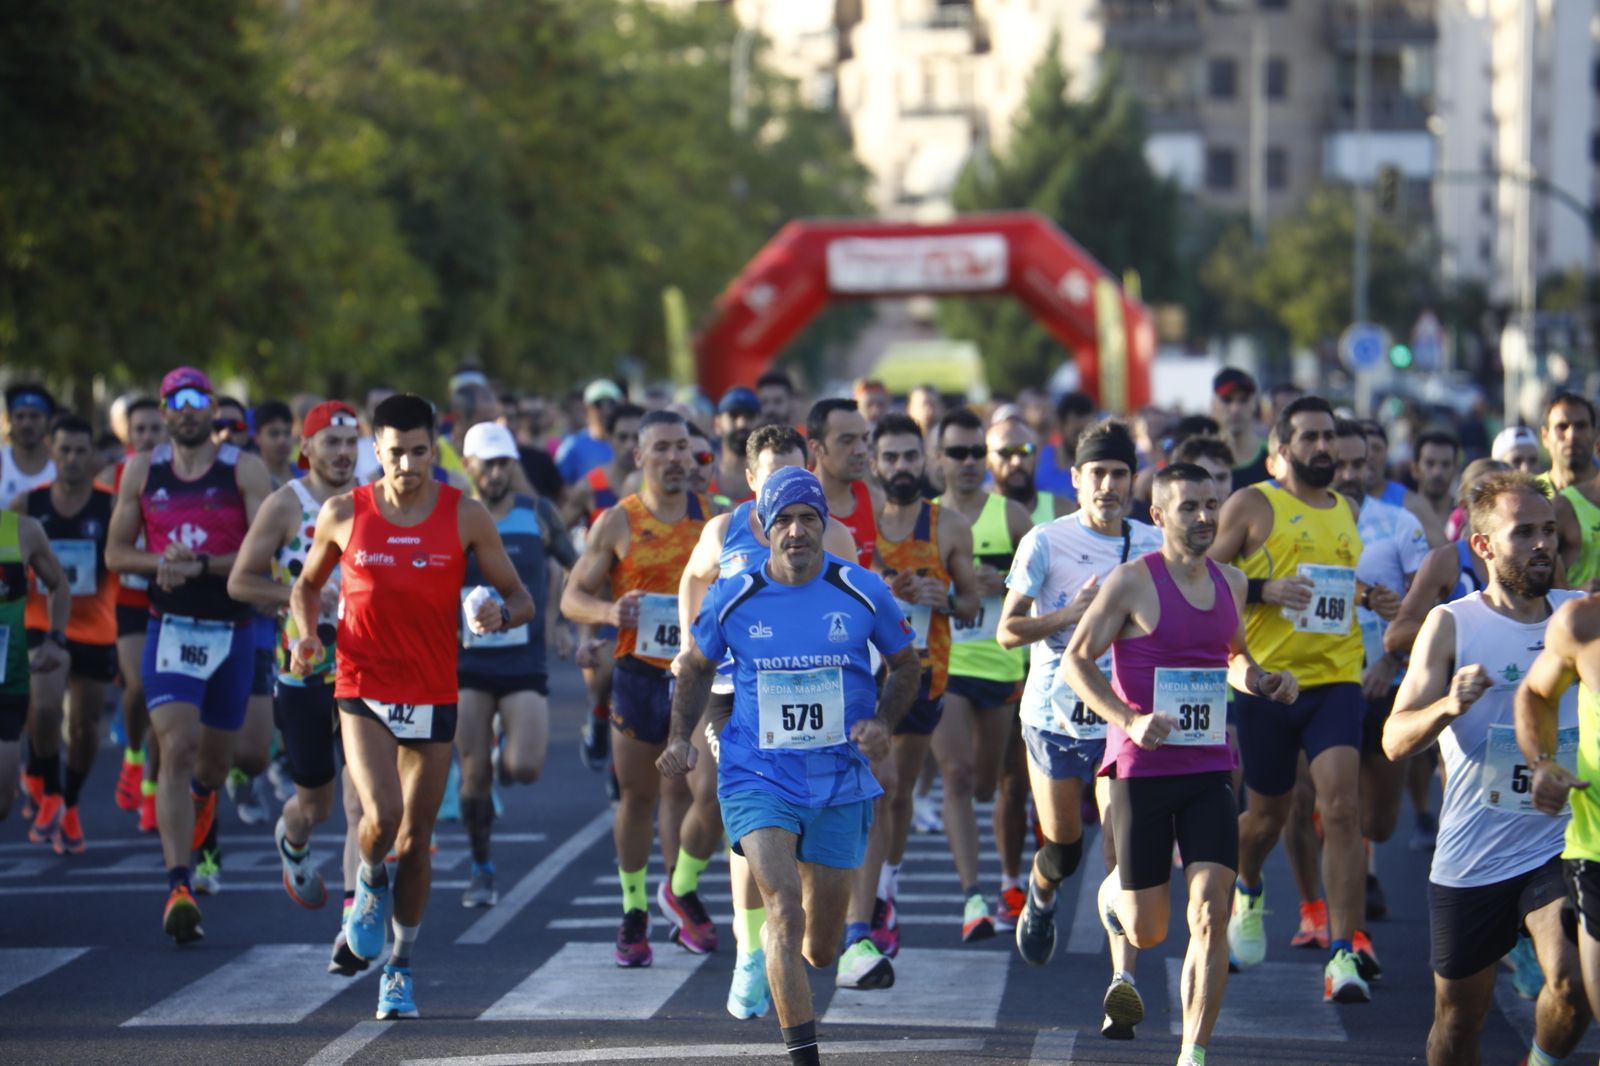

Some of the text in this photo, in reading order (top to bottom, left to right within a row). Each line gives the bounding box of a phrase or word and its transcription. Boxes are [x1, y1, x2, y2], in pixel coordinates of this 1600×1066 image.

[654, 624, 681, 646] 48
[752, 653, 851, 670] TROTASIERRA
[761, 684, 792, 696] MEDIA
[781, 703, 824, 731] 579
[1179, 703, 1210, 731] 313
